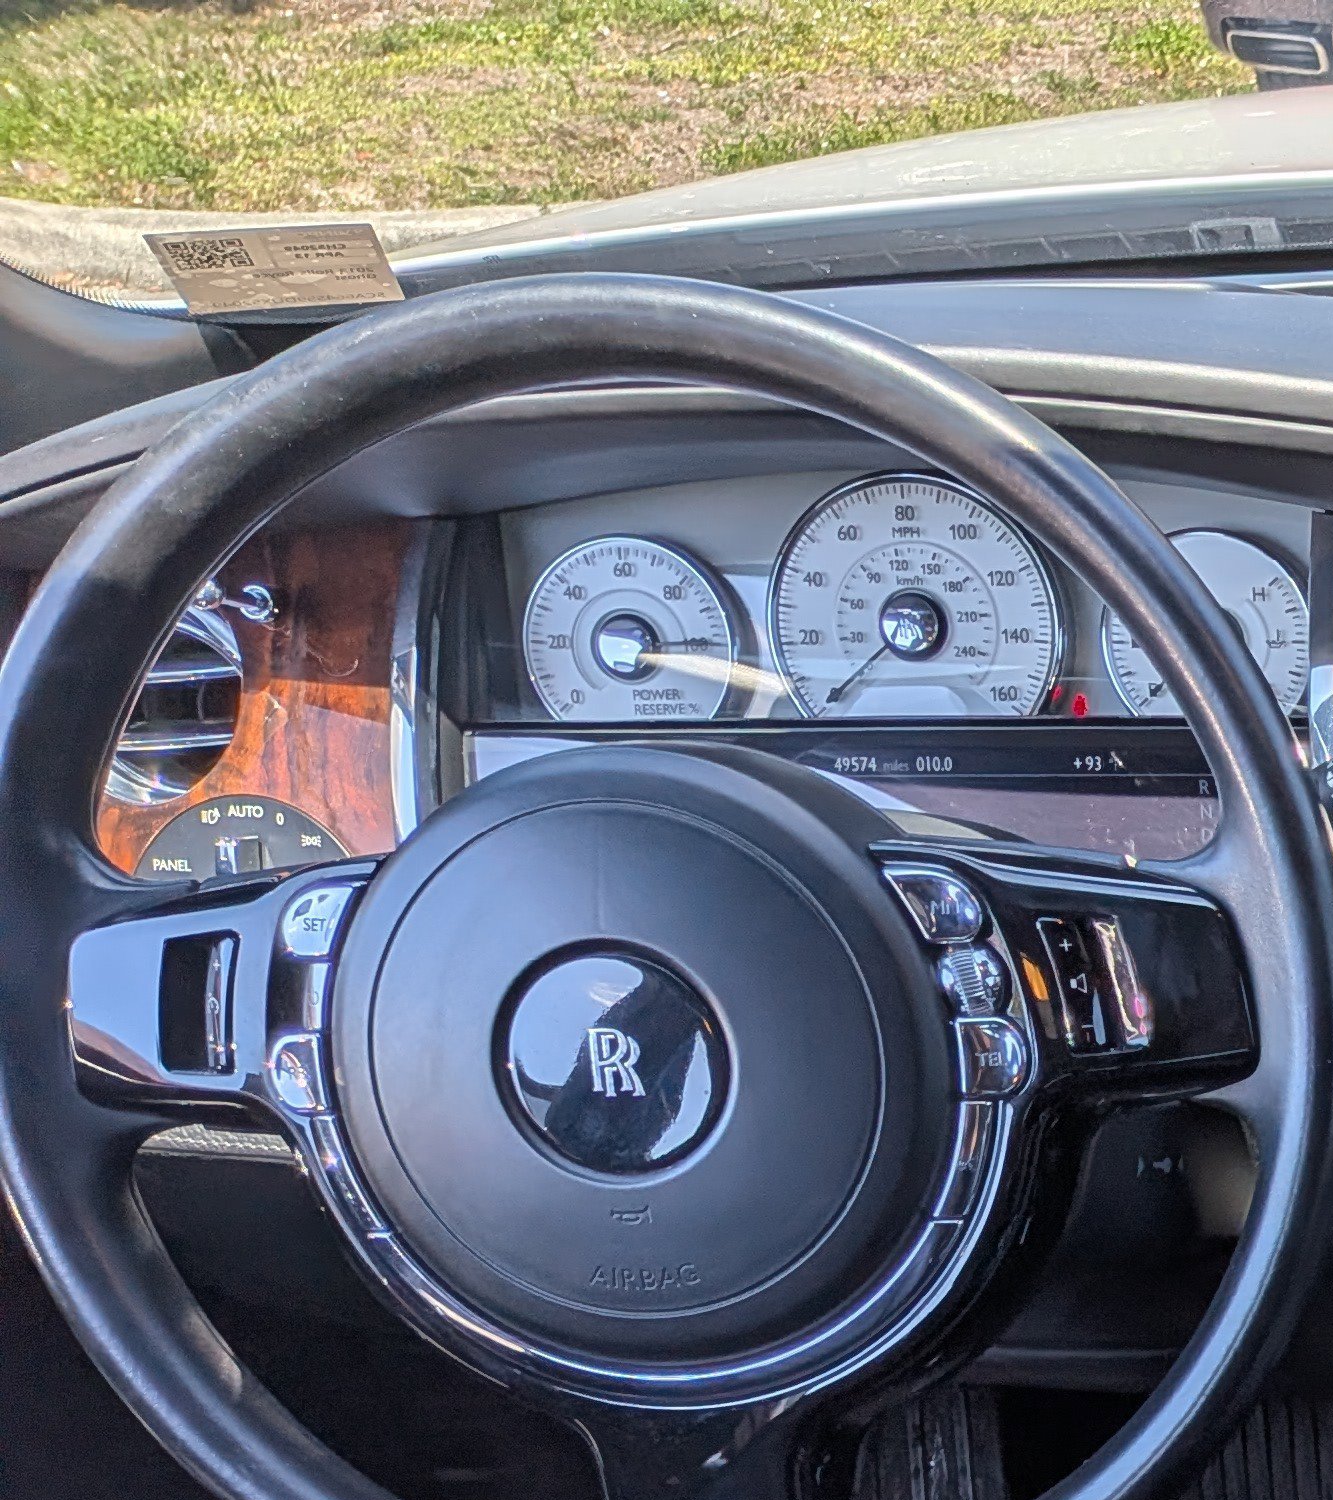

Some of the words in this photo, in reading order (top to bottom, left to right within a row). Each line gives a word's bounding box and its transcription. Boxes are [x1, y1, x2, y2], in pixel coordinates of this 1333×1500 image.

[894, 505, 915, 521] 80
[837, 525, 858, 541] 60
[891, 527, 920, 538] MPH
[949, 524, 977, 540] 100
[613, 562, 632, 577] 60
[888, 560, 909, 571] 120
[920, 563, 941, 575] 150
[803, 571, 823, 587] 40
[866, 572, 881, 583] 90
[896, 575, 923, 586] km/h
[987, 571, 1015, 587] 120
[563, 586, 583, 600] 40
[663, 585, 683, 600] 80
[942, 581, 963, 593] 180
[1252, 587, 1266, 601] H
[850, 599, 864, 610] 60
[956, 611, 978, 623] 210
[547, 635, 567, 649] 20
[799, 630, 820, 645] 20
[849, 632, 864, 643] 30
[1001, 628, 1030, 644] 140
[953, 646, 976, 657] 240
[571, 690, 581, 703] 0
[633, 689, 680, 700] POWER
[990, 686, 1018, 702] 160
[634, 704, 685, 715] RESERVE
[687, 704, 699, 714] %
[834, 757, 877, 772] 49574
[882, 759, 910, 772] miles
[915, 756, 953, 772] 010.0
[1073, 756, 1102, 771] +93
[1198, 779, 1210, 795] R
[227, 805, 264, 818] AUTO
[1200, 804, 1213, 820] N
[275, 813, 285, 825] 0
[153, 859, 192, 872] PANEL
[303, 918, 326, 932] SET
[587, 1028, 647, 1097] RR
[589, 1263, 701, 1291] AIRBAG
